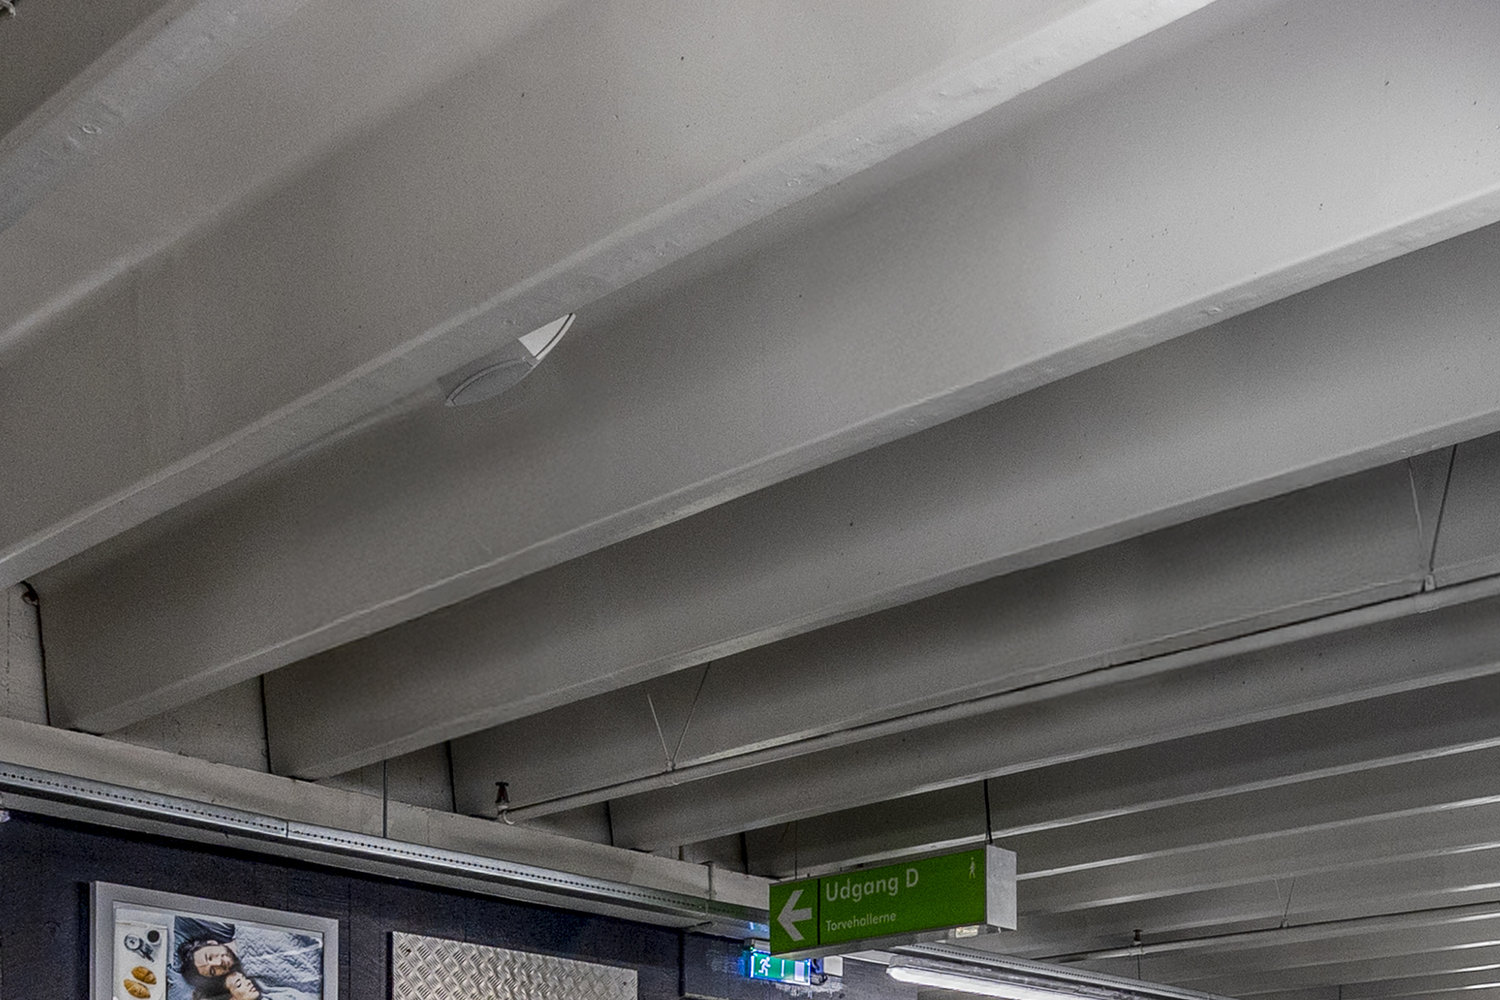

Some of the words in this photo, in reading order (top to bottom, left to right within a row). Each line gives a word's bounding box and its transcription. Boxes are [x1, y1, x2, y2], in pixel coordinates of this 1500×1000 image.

[826, 877, 899, 903] Udgang
[906, 867, 919, 888] D
[826, 912, 897, 932] Torvehallerne
